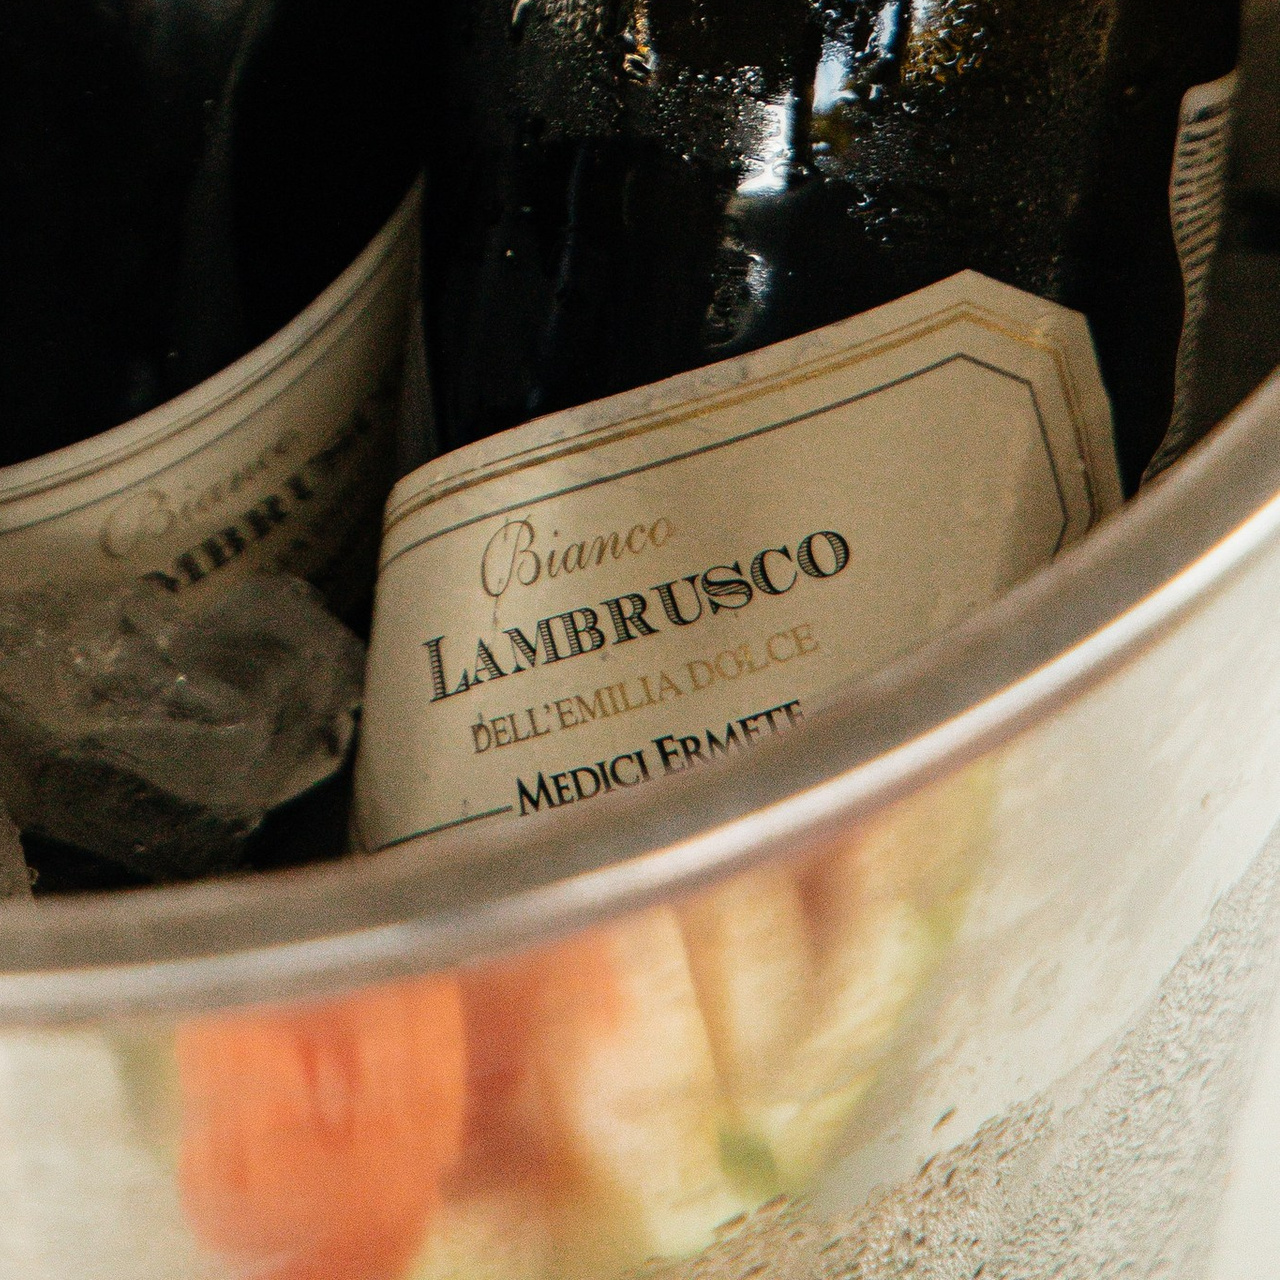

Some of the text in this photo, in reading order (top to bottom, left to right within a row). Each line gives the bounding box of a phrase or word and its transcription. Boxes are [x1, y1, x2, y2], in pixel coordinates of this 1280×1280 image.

[480, 516, 675, 598] Bianco
[423, 529, 851, 703] LAMBRUSCO
[470, 623, 821, 755] DELL'EMILIA DOLCE
[516, 748, 652, 817] MEDICI
